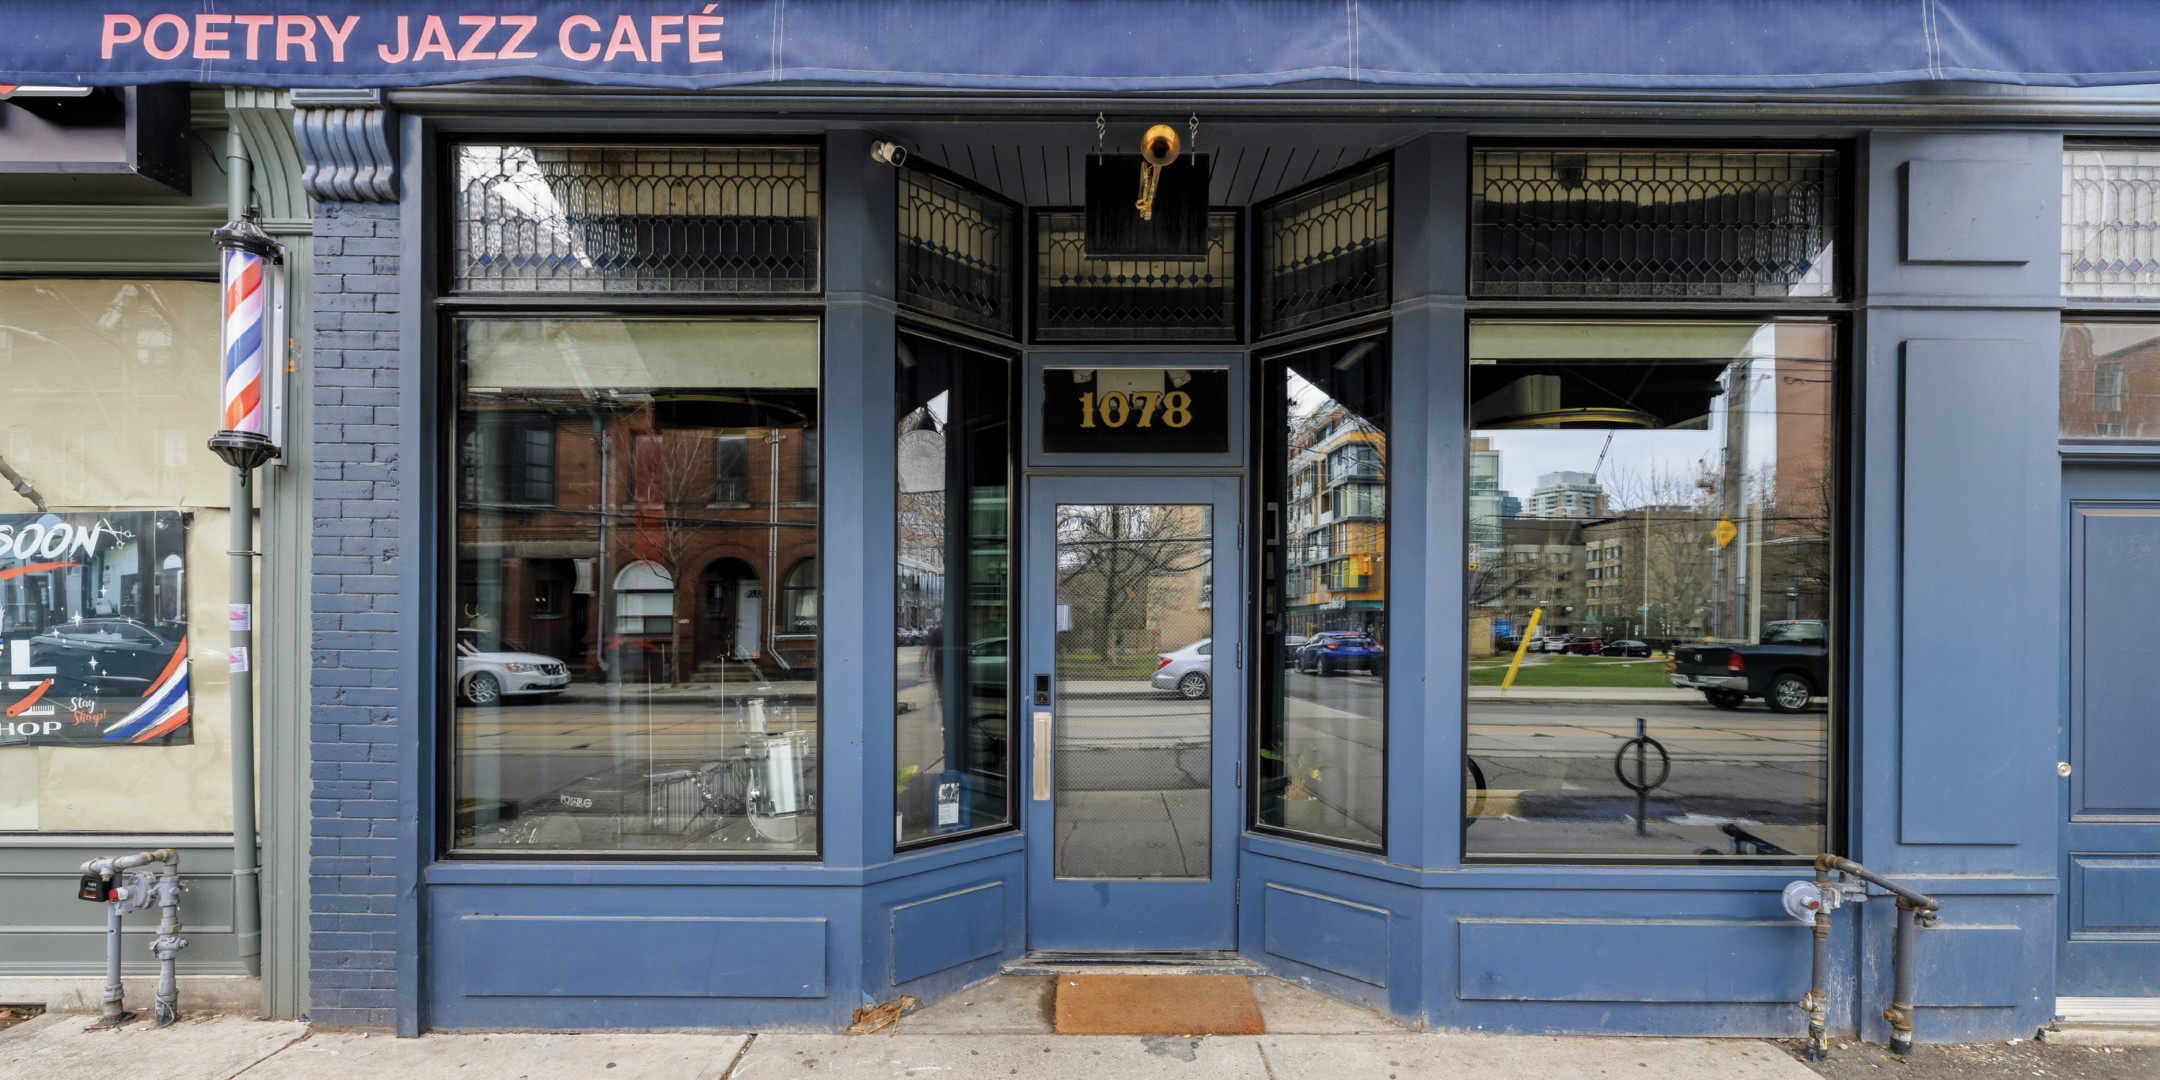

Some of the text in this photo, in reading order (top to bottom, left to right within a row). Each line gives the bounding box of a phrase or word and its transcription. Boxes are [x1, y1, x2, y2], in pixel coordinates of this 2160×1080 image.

[102, 4, 723, 62] POETRY JAZZ CAFÉ
[1078, 390, 1193, 430] 1078
[69, 696, 96, 714] Stay
